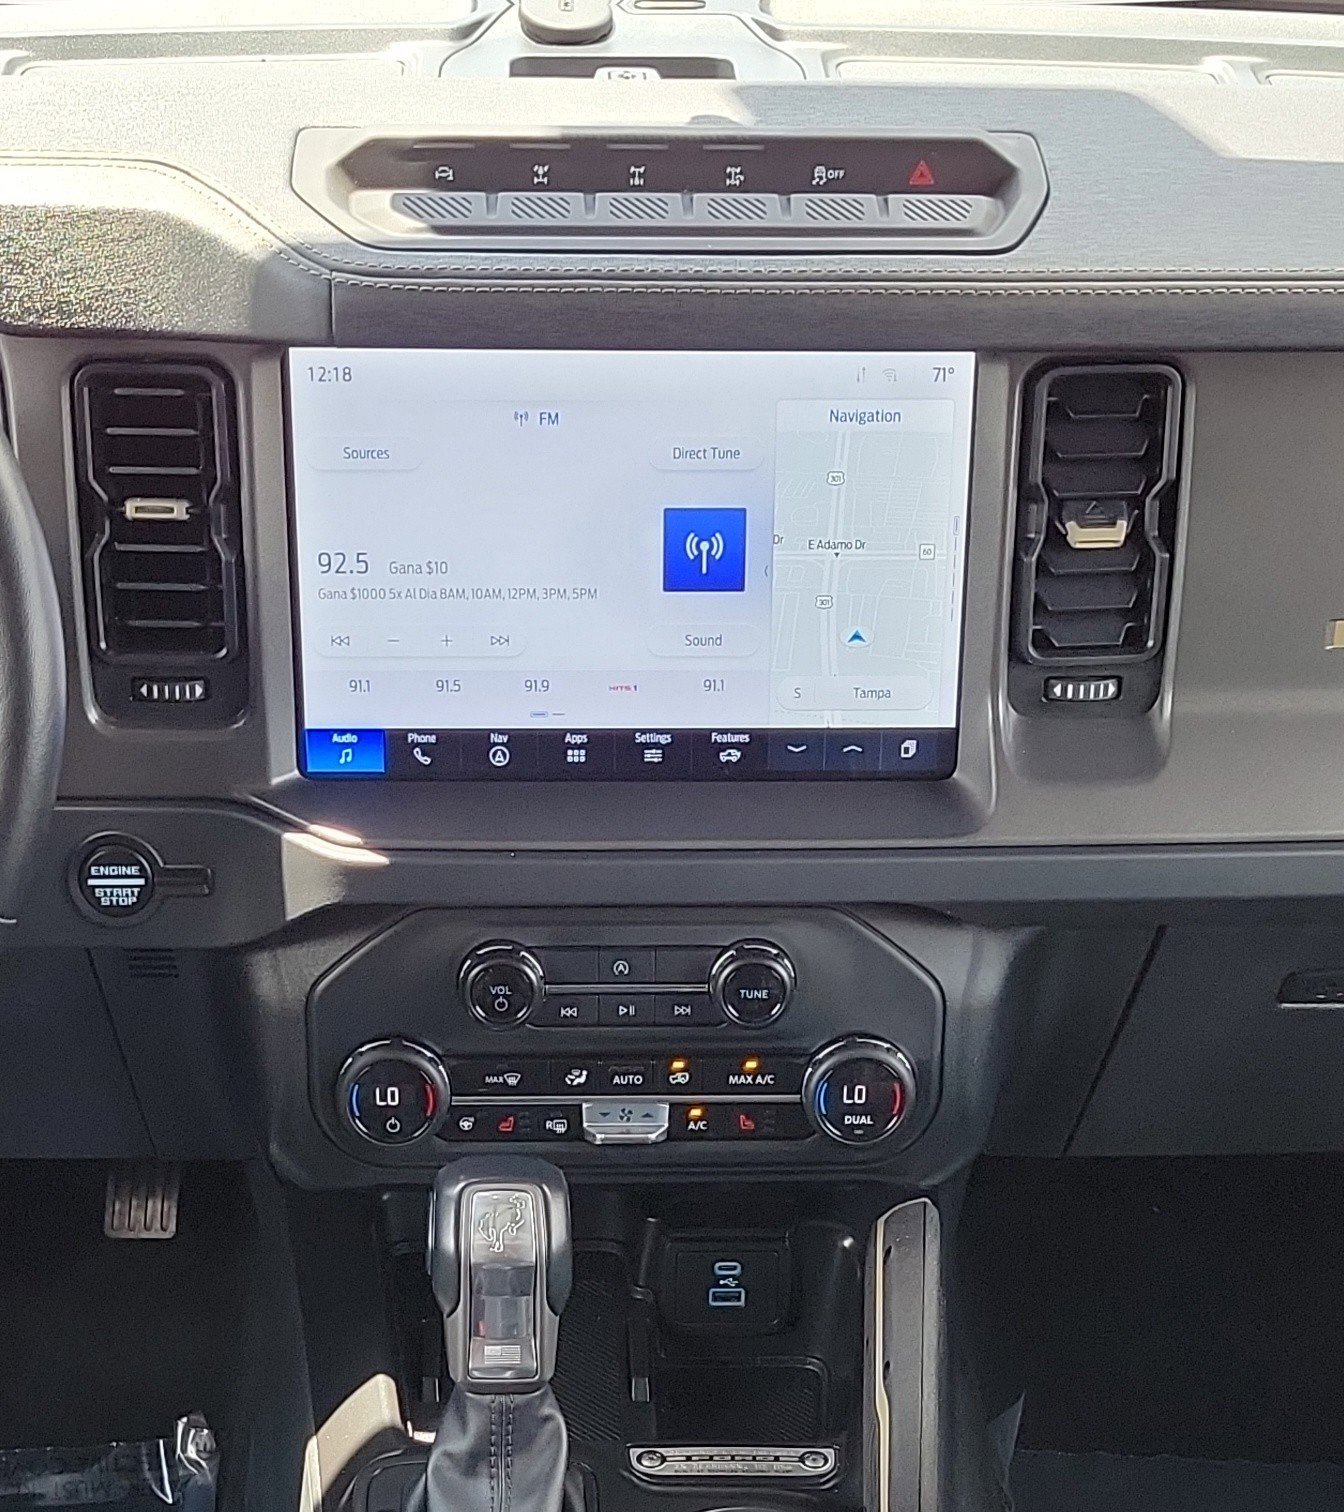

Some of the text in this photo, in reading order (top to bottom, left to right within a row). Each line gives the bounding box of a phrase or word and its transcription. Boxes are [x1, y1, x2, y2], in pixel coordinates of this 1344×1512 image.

[827, 169, 845, 180] OFF
[307, 366, 353, 382] 12:18
[539, 412, 559, 426] FM
[829, 409, 902, 425] Navigation
[343, 446, 390, 460] Sources
[672, 447, 741, 460] Direct Tune
[807, 539, 867, 550] E Adamo Dr
[317, 552, 449, 576] 92.5 Gana $10
[317, 587, 598, 602] Gana $1000 5x Al Dia 8AM, 10AM, 12PM, 3PM, 5PM
[684, 634, 723, 647] Sound
[349, 679, 371, 693] 91.1
[436, 679, 461, 693] 91.5
[524, 679, 550, 693] 91.9
[703, 679, 725, 692] 91.1
[794, 687, 802, 698] S
[853, 687, 892, 700] Tampa
[332, 733, 358, 744] Audio
[407, 733, 437, 744] Phone
[490, 733, 509, 744] Nav
[564, 733, 588, 745] Apps
[634, 732, 672, 745] Settings
[711, 732, 751, 743] Features
[90, 866, 141, 876] ENGINE
[94, 887, 141, 897] START
[100, 897, 138, 906] STOP
[489, 985, 512, 996] VOL
[739, 989, 769, 1000] TUNE
[485, 1075, 504, 1084] MAX
[612, 1075, 643, 1085] AUTO
[728, 1074, 775, 1085] MAX A/C
[375, 1086, 400, 1106] LO
[842, 1084, 867, 1105] LO
[687, 1120, 708, 1131] A/C
[844, 1115, 874, 1125] DUAL
